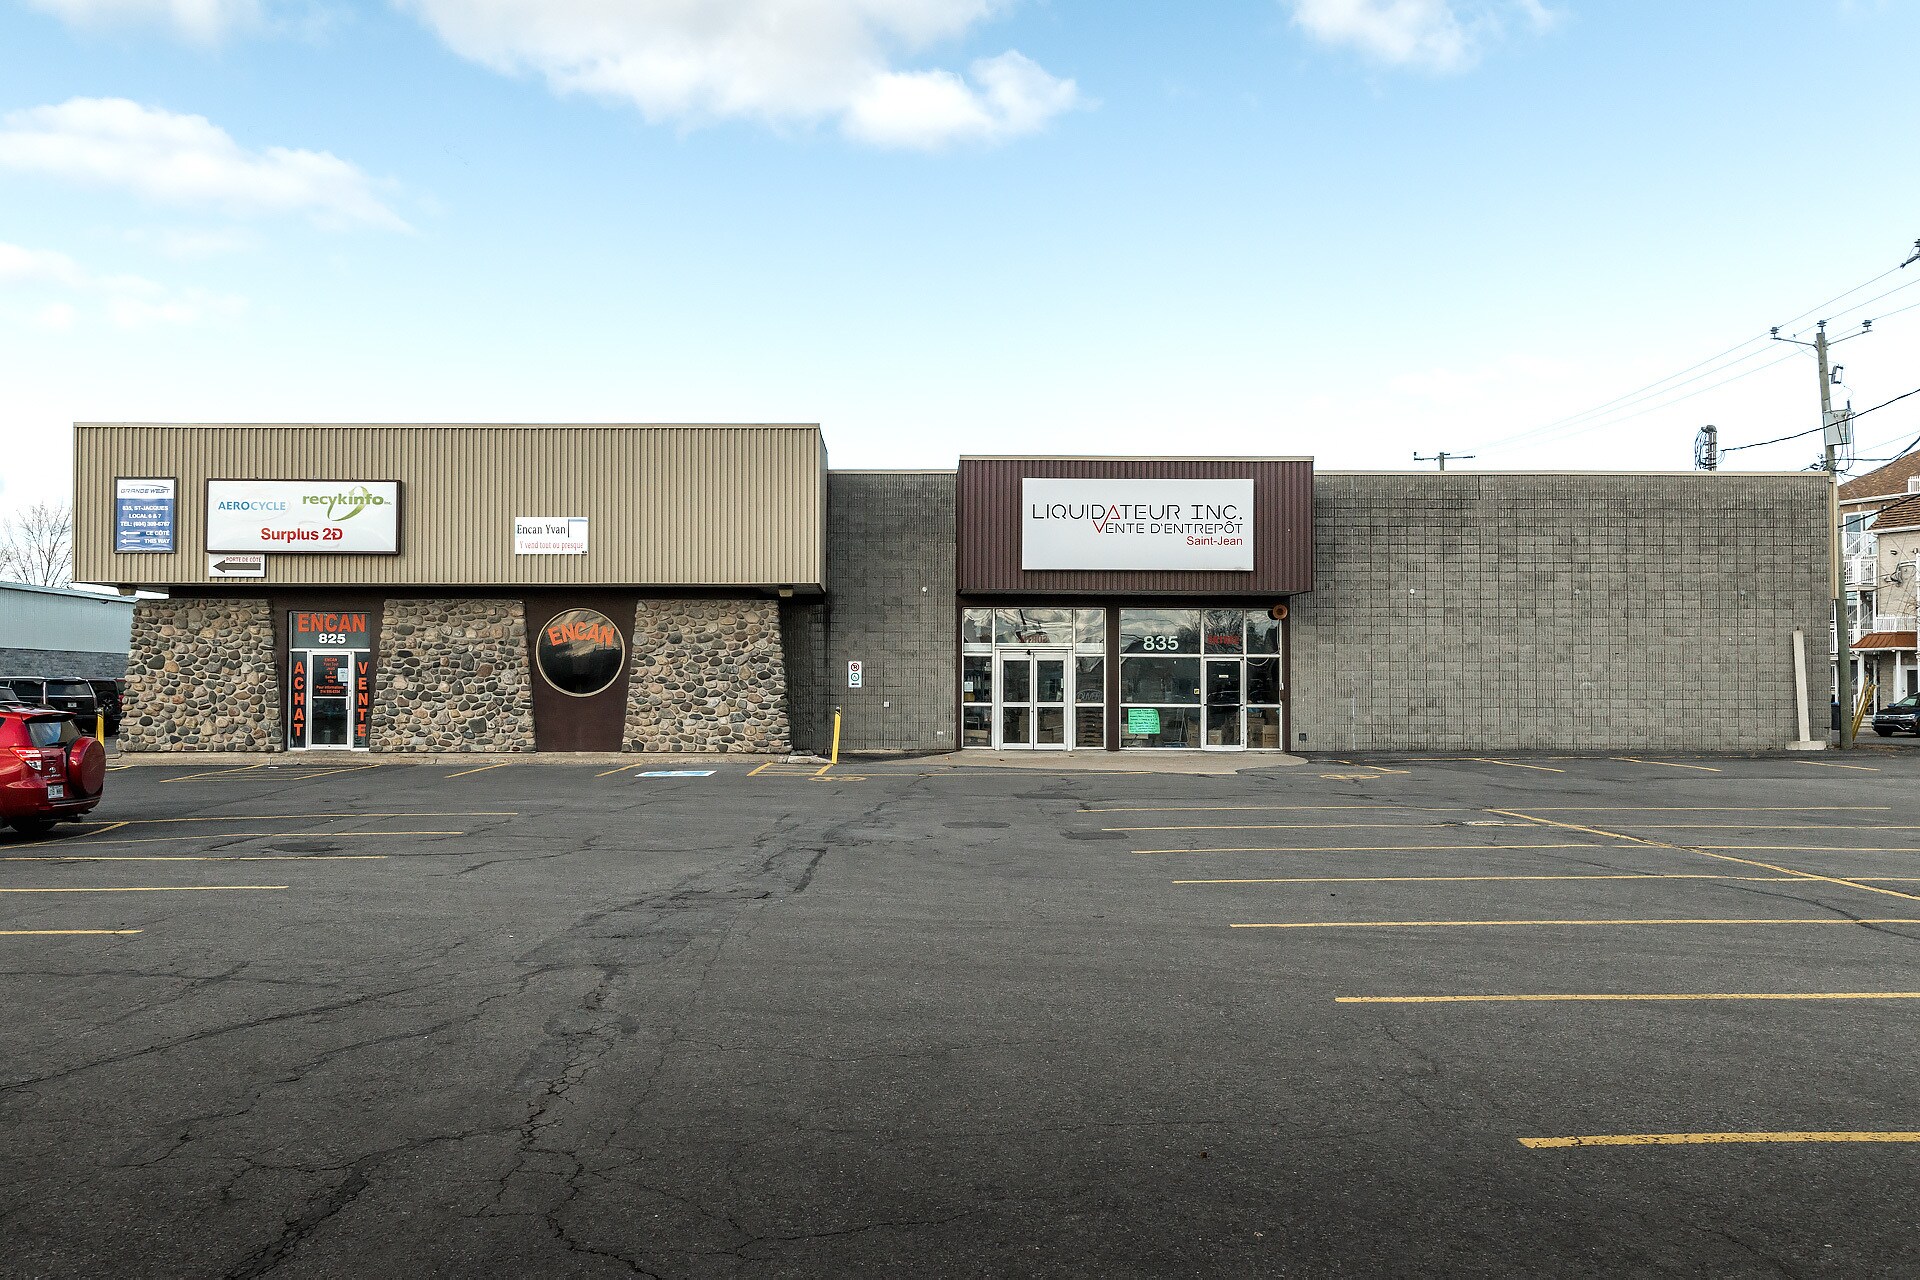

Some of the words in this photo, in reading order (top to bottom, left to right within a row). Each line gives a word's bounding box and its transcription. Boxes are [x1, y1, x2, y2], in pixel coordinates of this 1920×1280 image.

[218, 501, 286, 511] AEROCYCLE
[1032, 503, 1181, 520] LIQUIDATEUR
[1191, 504, 1244, 520] INC.
[260, 528, 319, 543] Surplus
[517, 524, 543, 534] Encan
[545, 524, 566, 534] Yvan
[1186, 535, 1244, 546] Saint-Jean
[297, 613, 366, 632] ENCAN
[318, 633, 346, 644] 825
[547, 621, 615, 647] ENCAN
[1143, 635, 1179, 651] 835
[293, 661, 305, 737] ACHAT
[357, 661, 369, 737] VENTE
